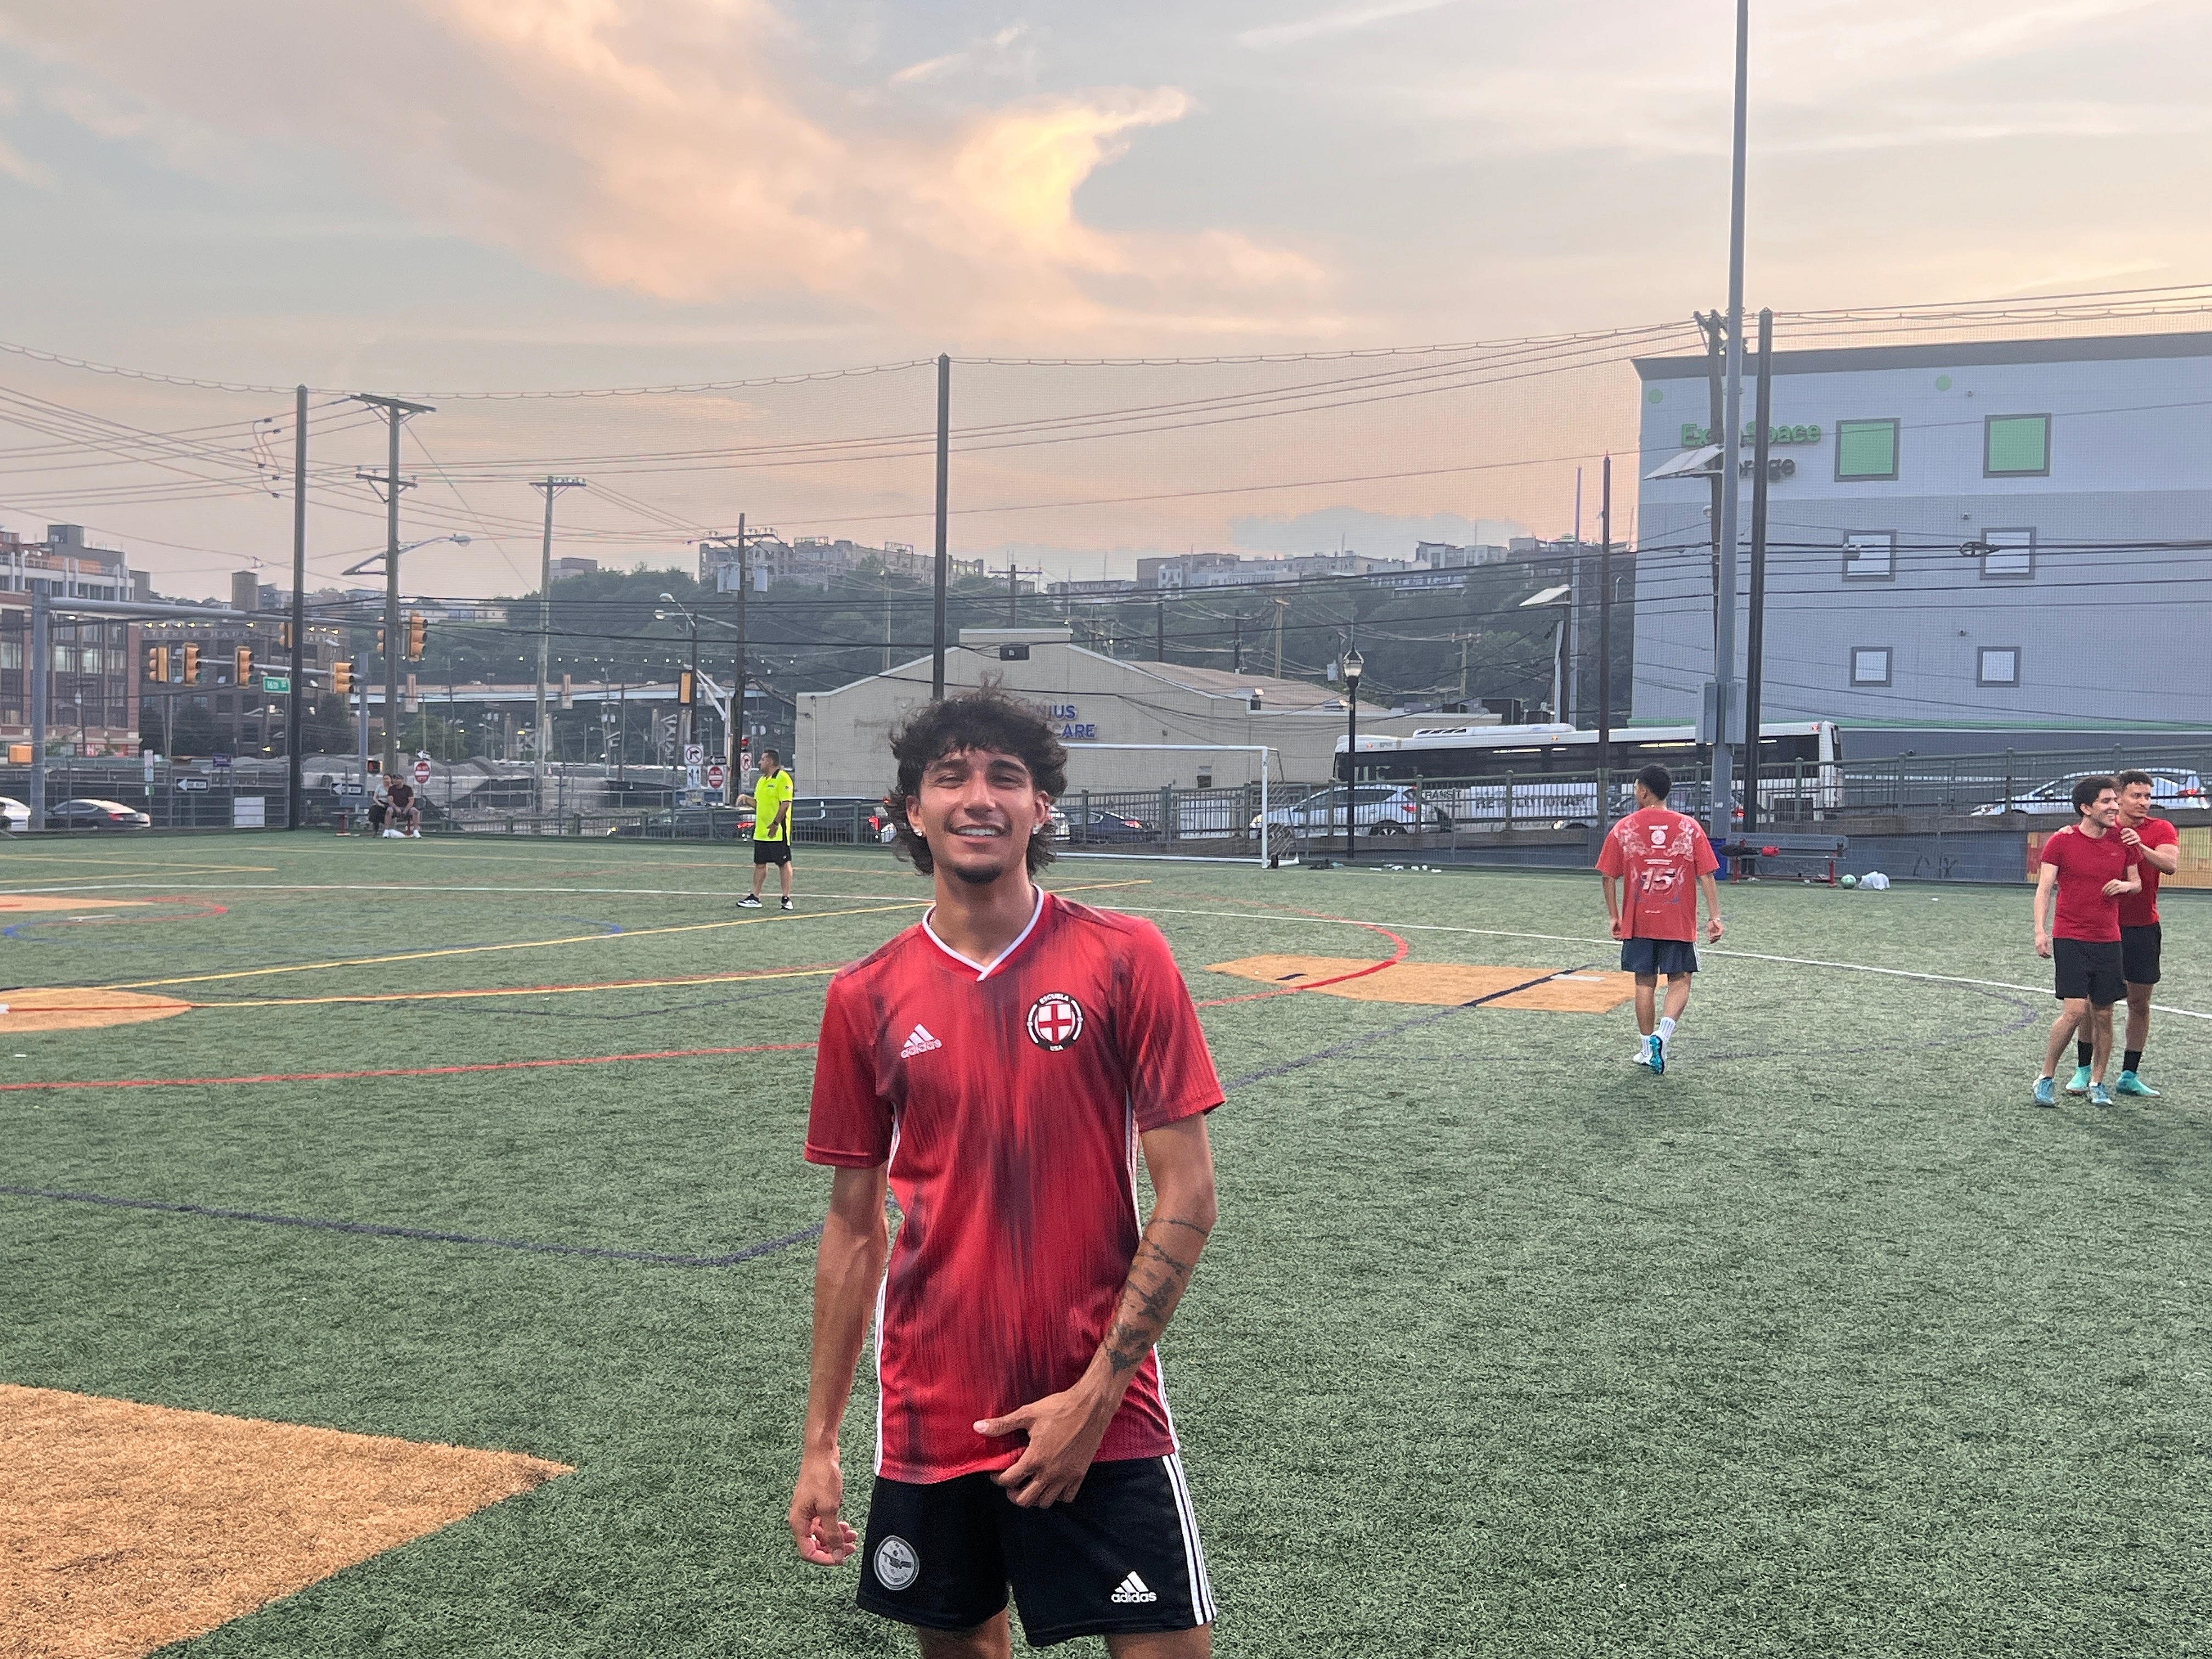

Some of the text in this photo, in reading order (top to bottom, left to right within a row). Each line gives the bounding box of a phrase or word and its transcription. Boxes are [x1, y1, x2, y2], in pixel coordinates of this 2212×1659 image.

[1640, 868, 1676, 891] 15
[900, 1039, 943, 1058] adidas
[1110, 1591, 1158, 1603] adidas
